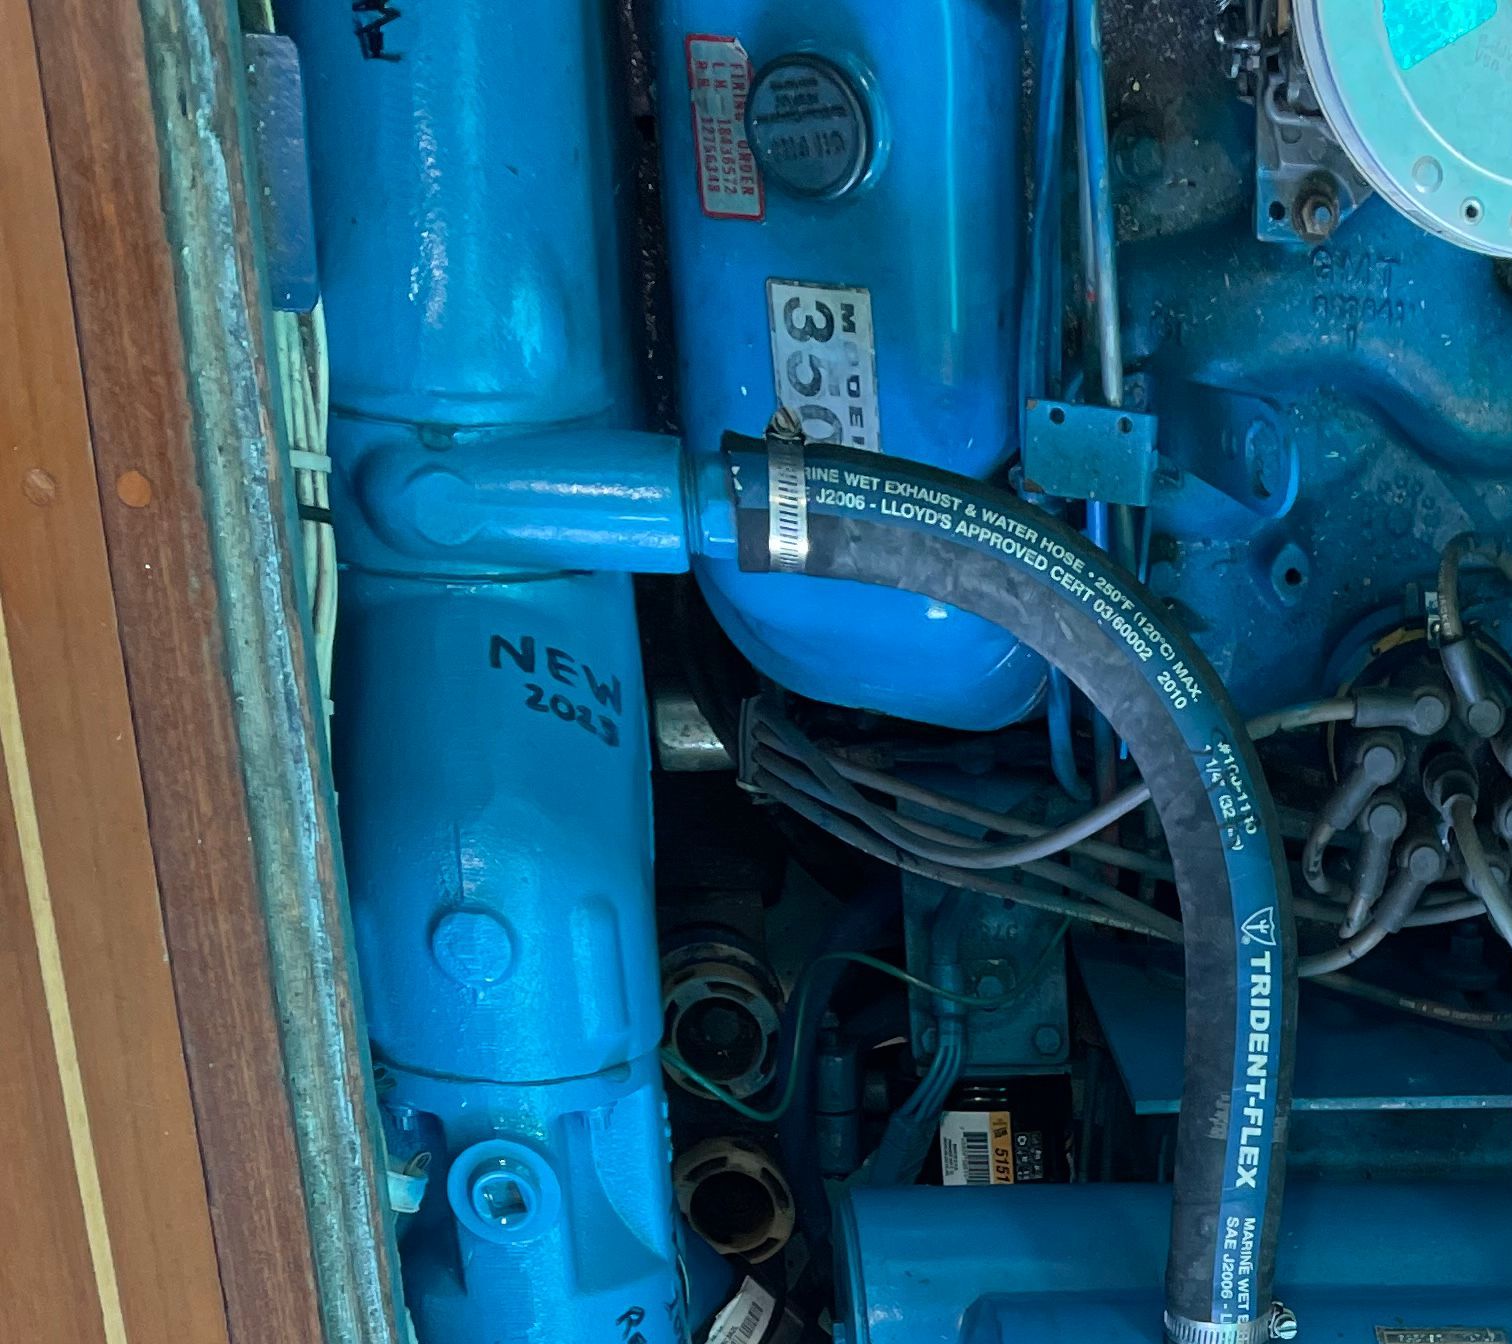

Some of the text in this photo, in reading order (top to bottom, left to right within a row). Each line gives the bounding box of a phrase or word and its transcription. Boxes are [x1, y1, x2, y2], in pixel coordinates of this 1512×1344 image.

[783, 297, 843, 444] 350
[803, 465, 840, 483] RINE
[843, 471, 881, 491] WET
[884, 480, 962, 511] EXHAUST
[964, 503, 976, 518] &
[981, 507, 1038, 543] WATER
[1040, 535, 1085, 573] HOSE
[1172, 661, 1202, 702] MAX.
[815, 488, 866, 510] J2006
[880, 498, 953, 530] LLOYD'S
[955, 520, 1049, 571] APPROVED
[1050, 565, 1095, 602] CERT
[1093, 599, 1154, 662] 03/60002
[1156, 671, 1187, 710] 2010
[489, 633, 624, 716] NEW
[524, 683, 620, 747] 2023
[1235, 951, 1271, 1189] TRIDENT-FLEX
[1224, 1216, 1239, 1250] SAE
[1238, 1217, 1256, 1275] MARINE
[1220, 1254, 1235, 1299] J2006
[1237, 1278, 1250, 1311] WET
